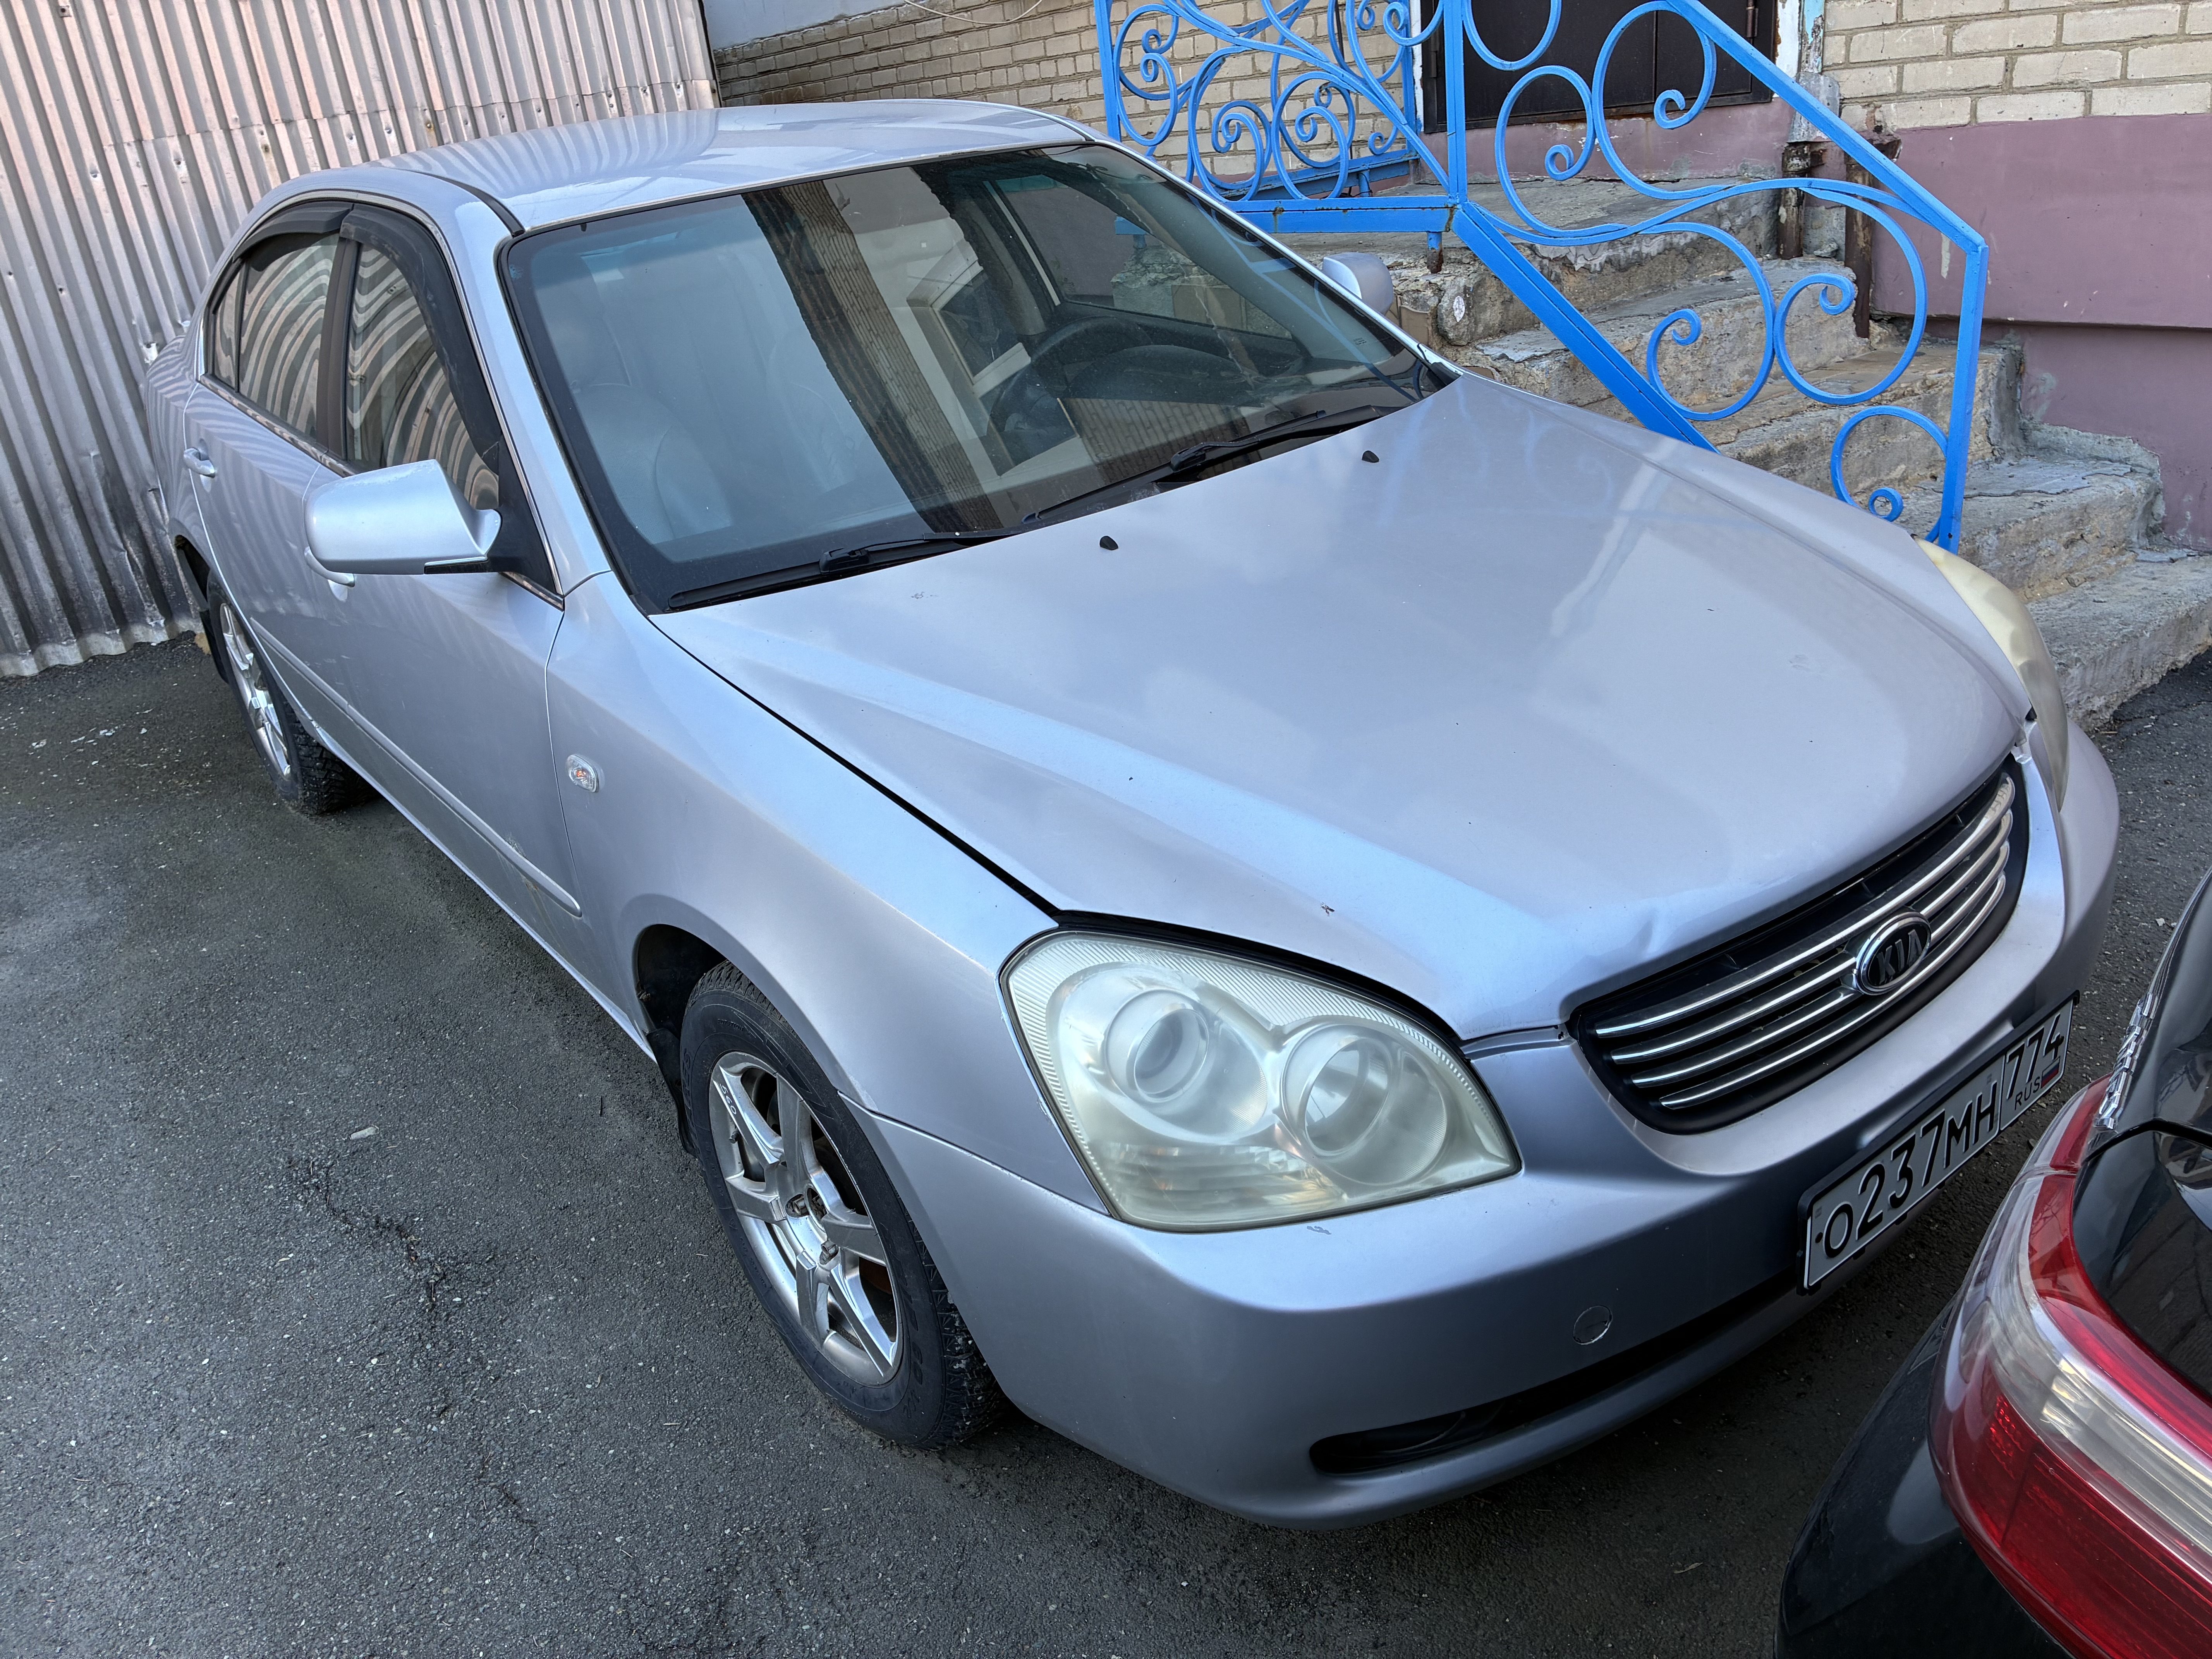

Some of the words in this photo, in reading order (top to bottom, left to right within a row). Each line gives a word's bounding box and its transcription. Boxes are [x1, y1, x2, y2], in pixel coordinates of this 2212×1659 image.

[1877, 929, 1922, 985] KIA
[2006, 1014, 2063, 1100] 774
[2014, 1077, 2041, 1111] RUS
